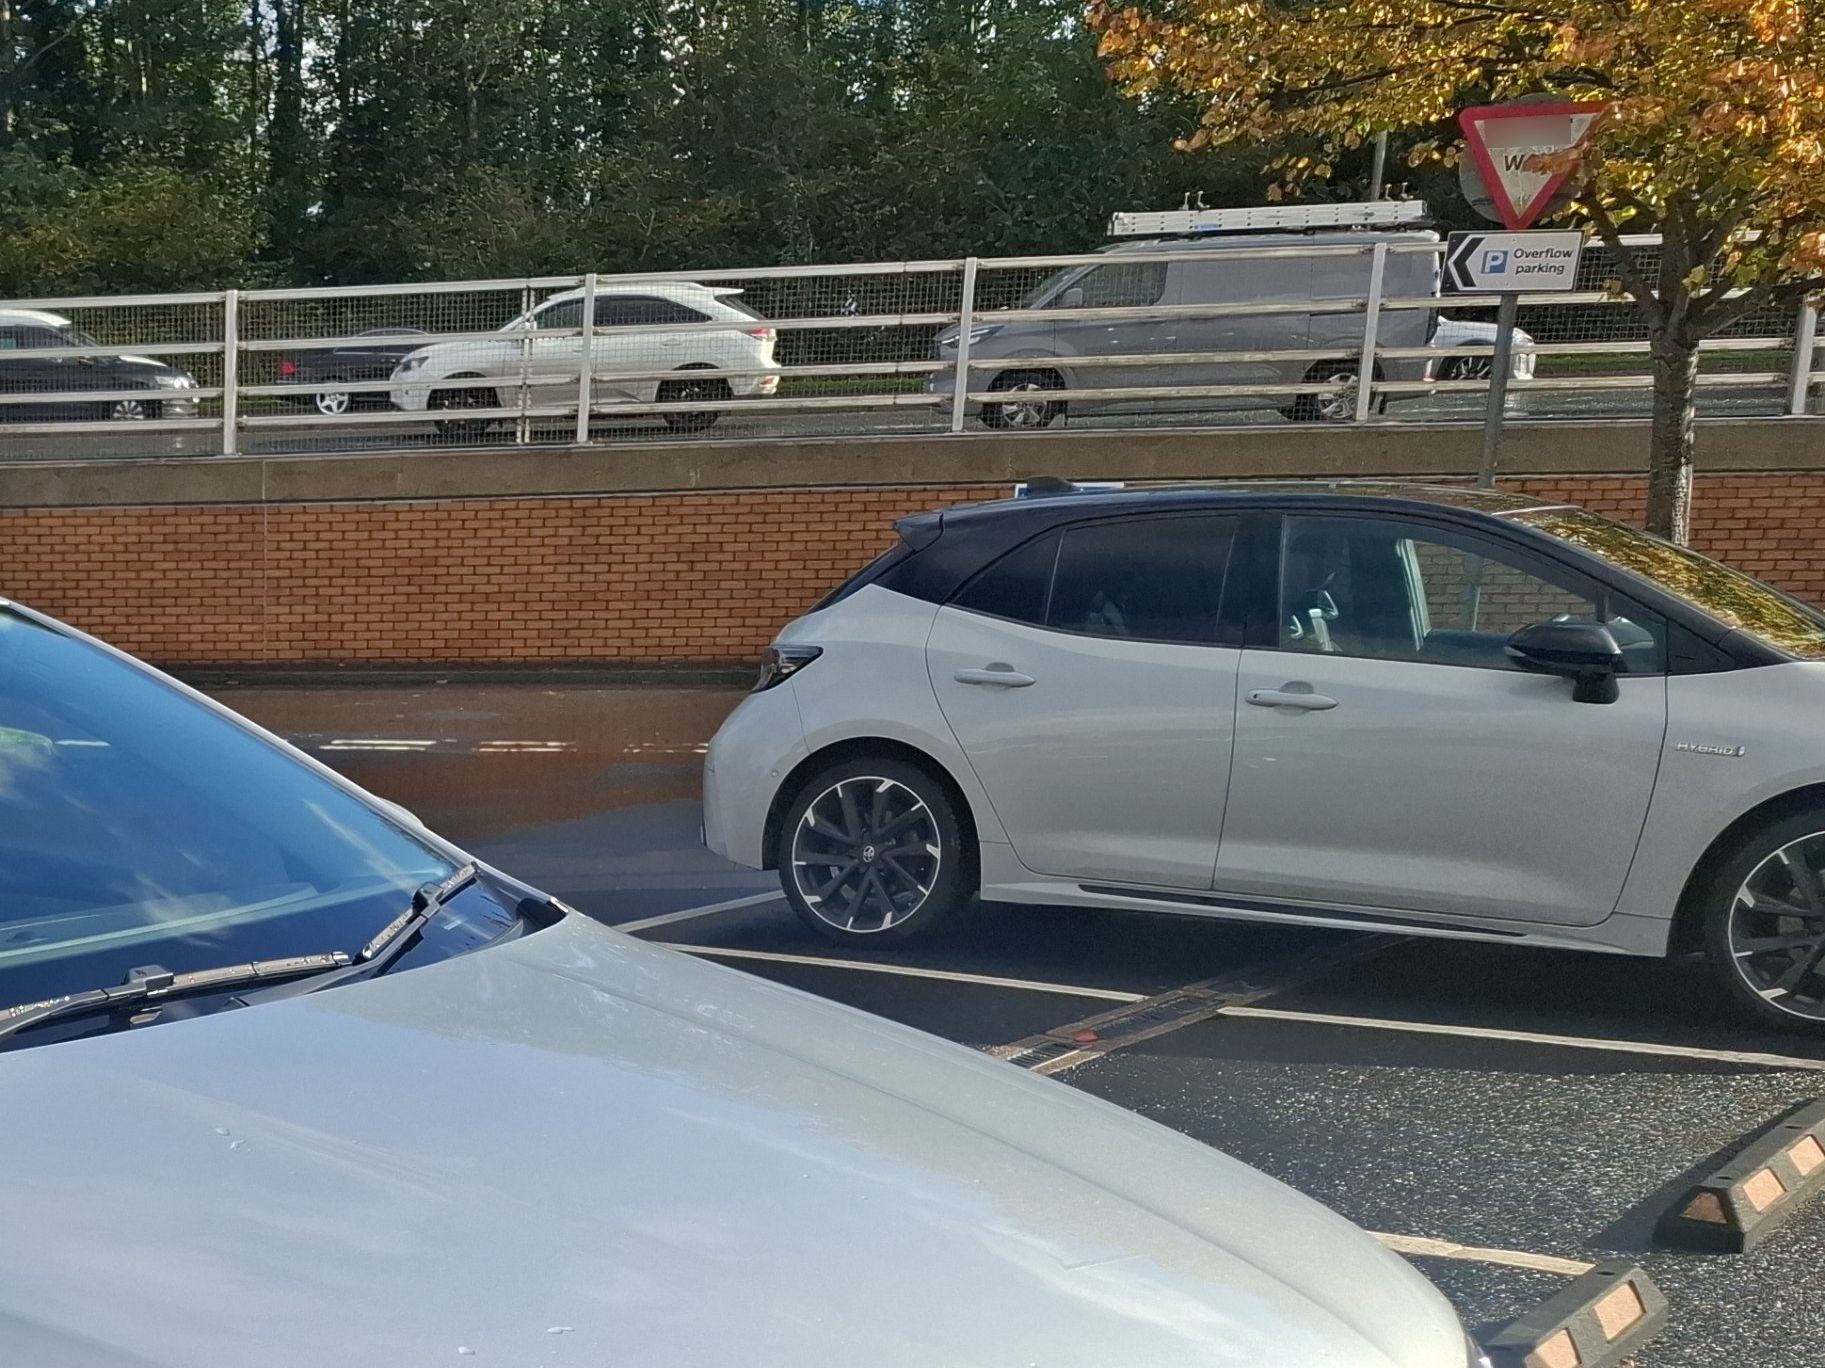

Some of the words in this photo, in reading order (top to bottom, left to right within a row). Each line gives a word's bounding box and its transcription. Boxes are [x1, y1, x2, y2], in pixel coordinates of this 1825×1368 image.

[1513, 247, 1574, 259] Overflow
[1484, 251, 1505, 273] P
[1515, 263, 1566, 275] parking
[1676, 742, 1735, 756] HYBRID
